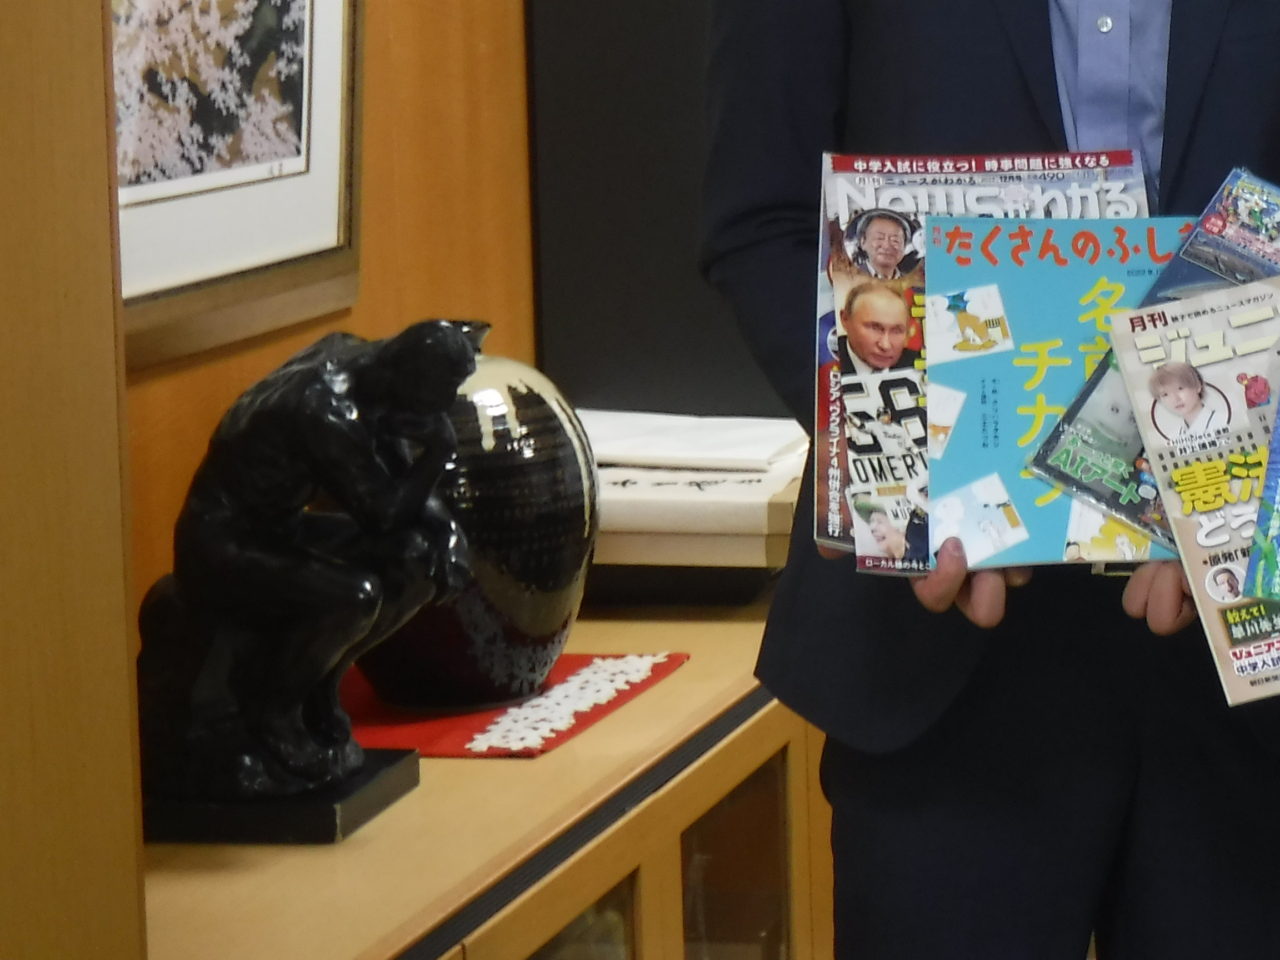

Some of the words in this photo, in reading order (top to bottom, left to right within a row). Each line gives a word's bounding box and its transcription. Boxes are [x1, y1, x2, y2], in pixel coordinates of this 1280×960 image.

[984, 154, 1110, 172] 時事問題に強くなる
[1129, 311, 1169, 333] 月刊
